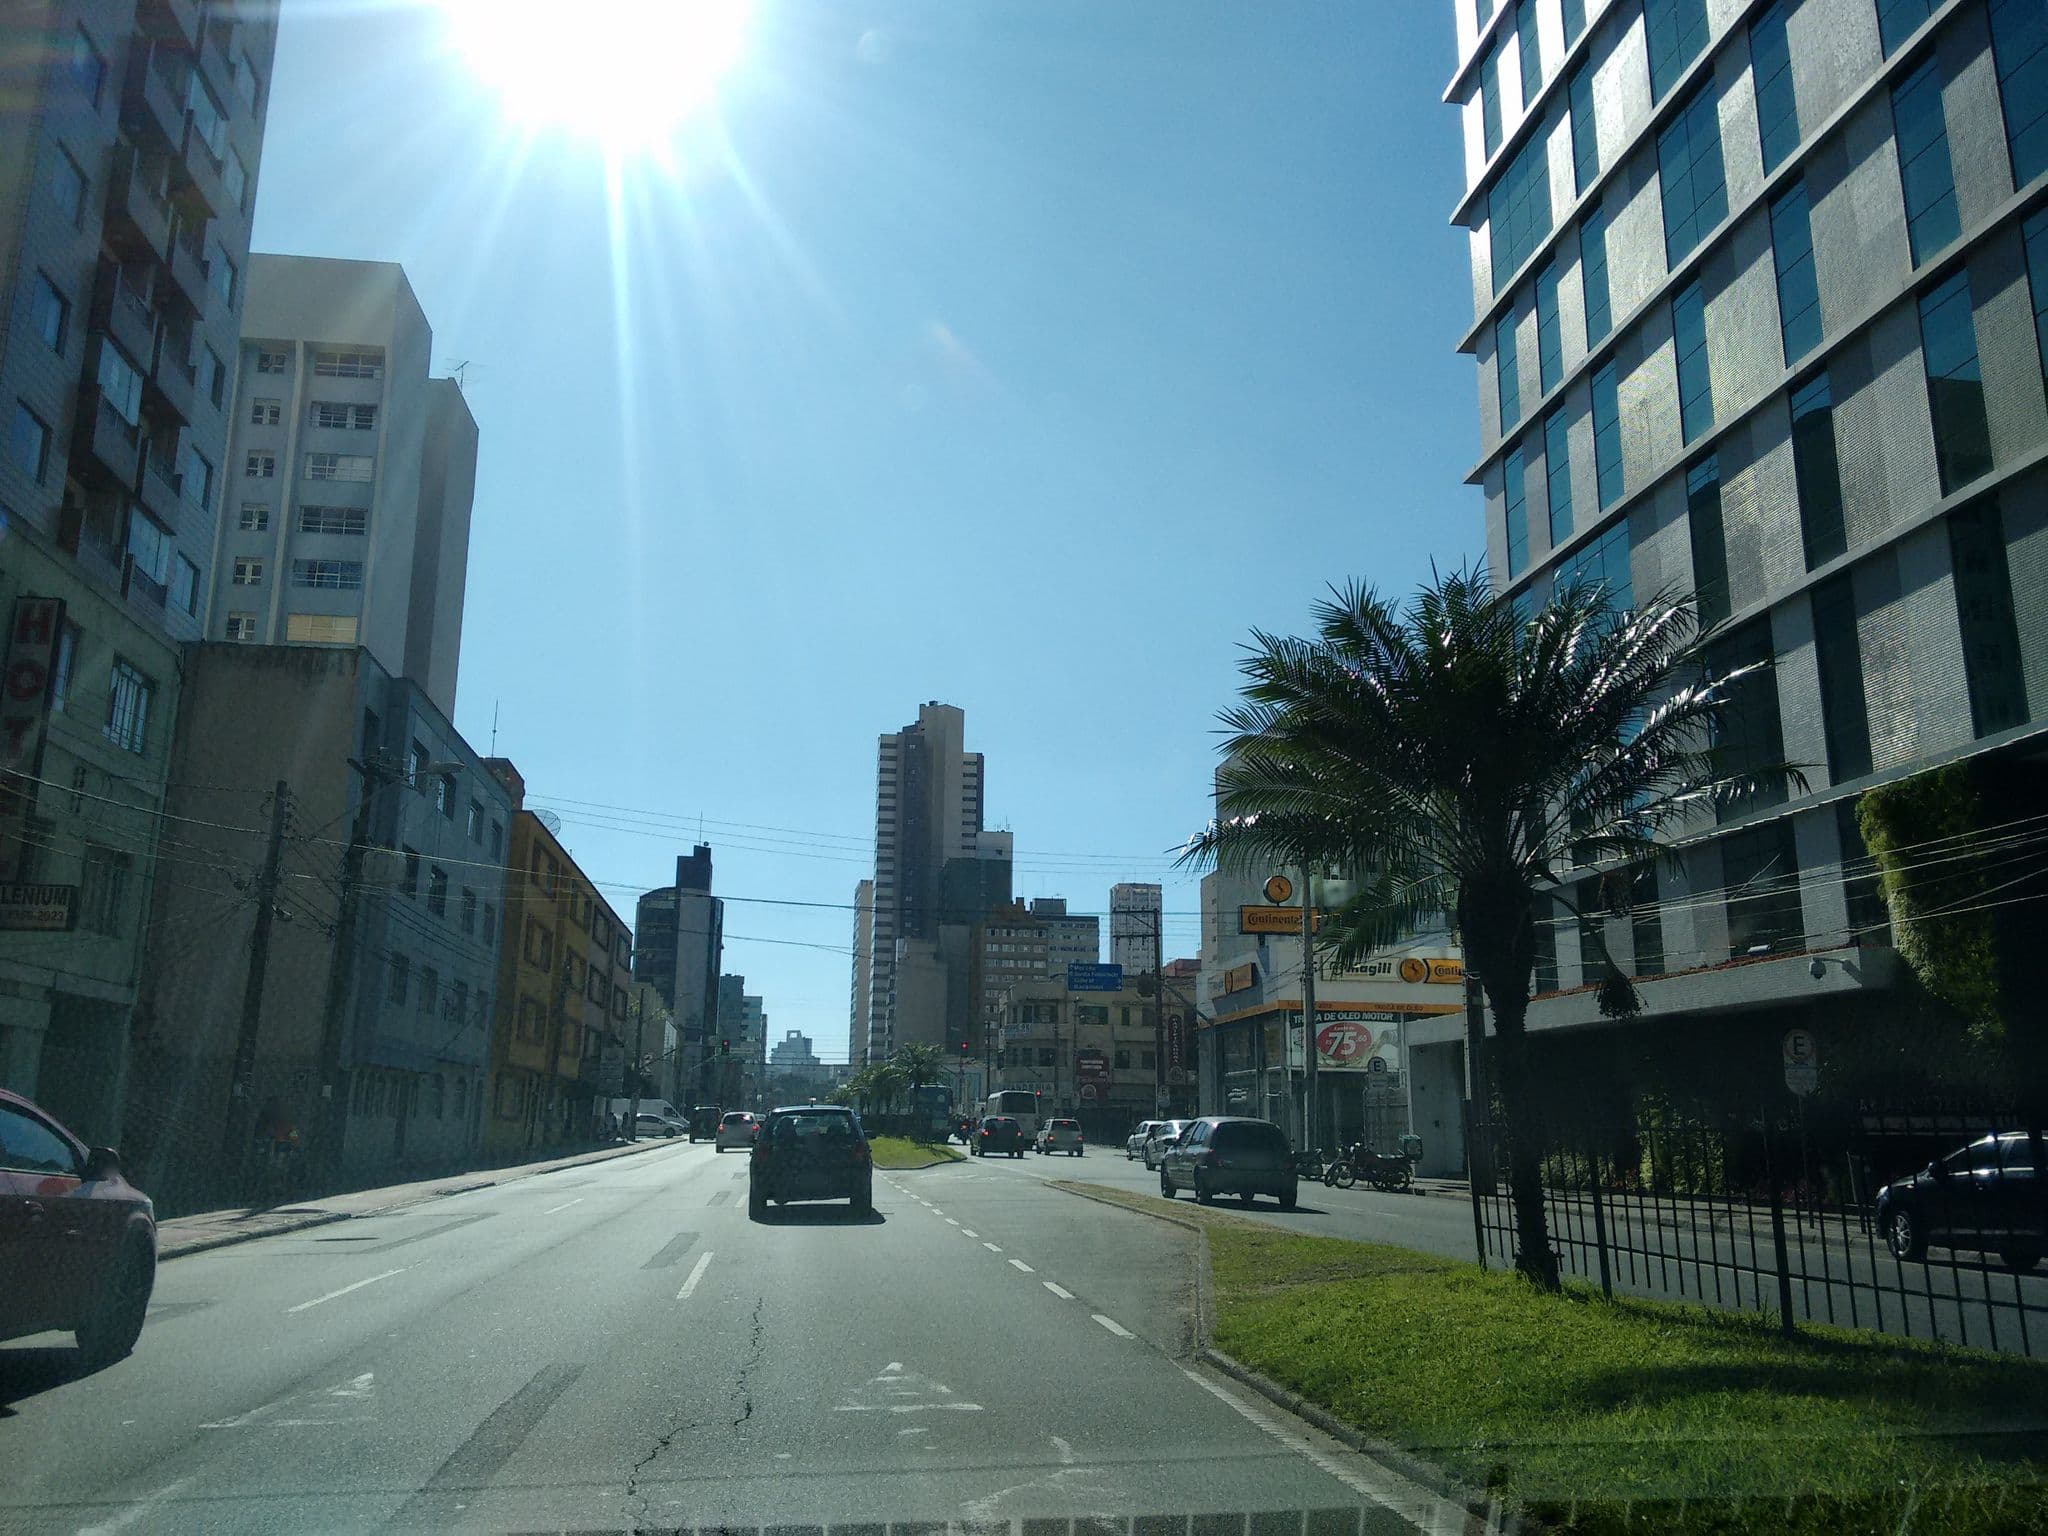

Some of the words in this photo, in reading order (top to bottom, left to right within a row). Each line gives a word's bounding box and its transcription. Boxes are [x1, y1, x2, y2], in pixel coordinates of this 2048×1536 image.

[1247, 912, 1303, 926] Continental
[1293, 1013, 1322, 1024] TRA
[1324, 1013, 1337, 1021] DE
[1362, 1012, 1394, 1021] MOTOR
[1327, 1031, 1357, 1056] 75
[1793, 1035, 1805, 1056] E
[1373, 1060, 1382, 1072] E
